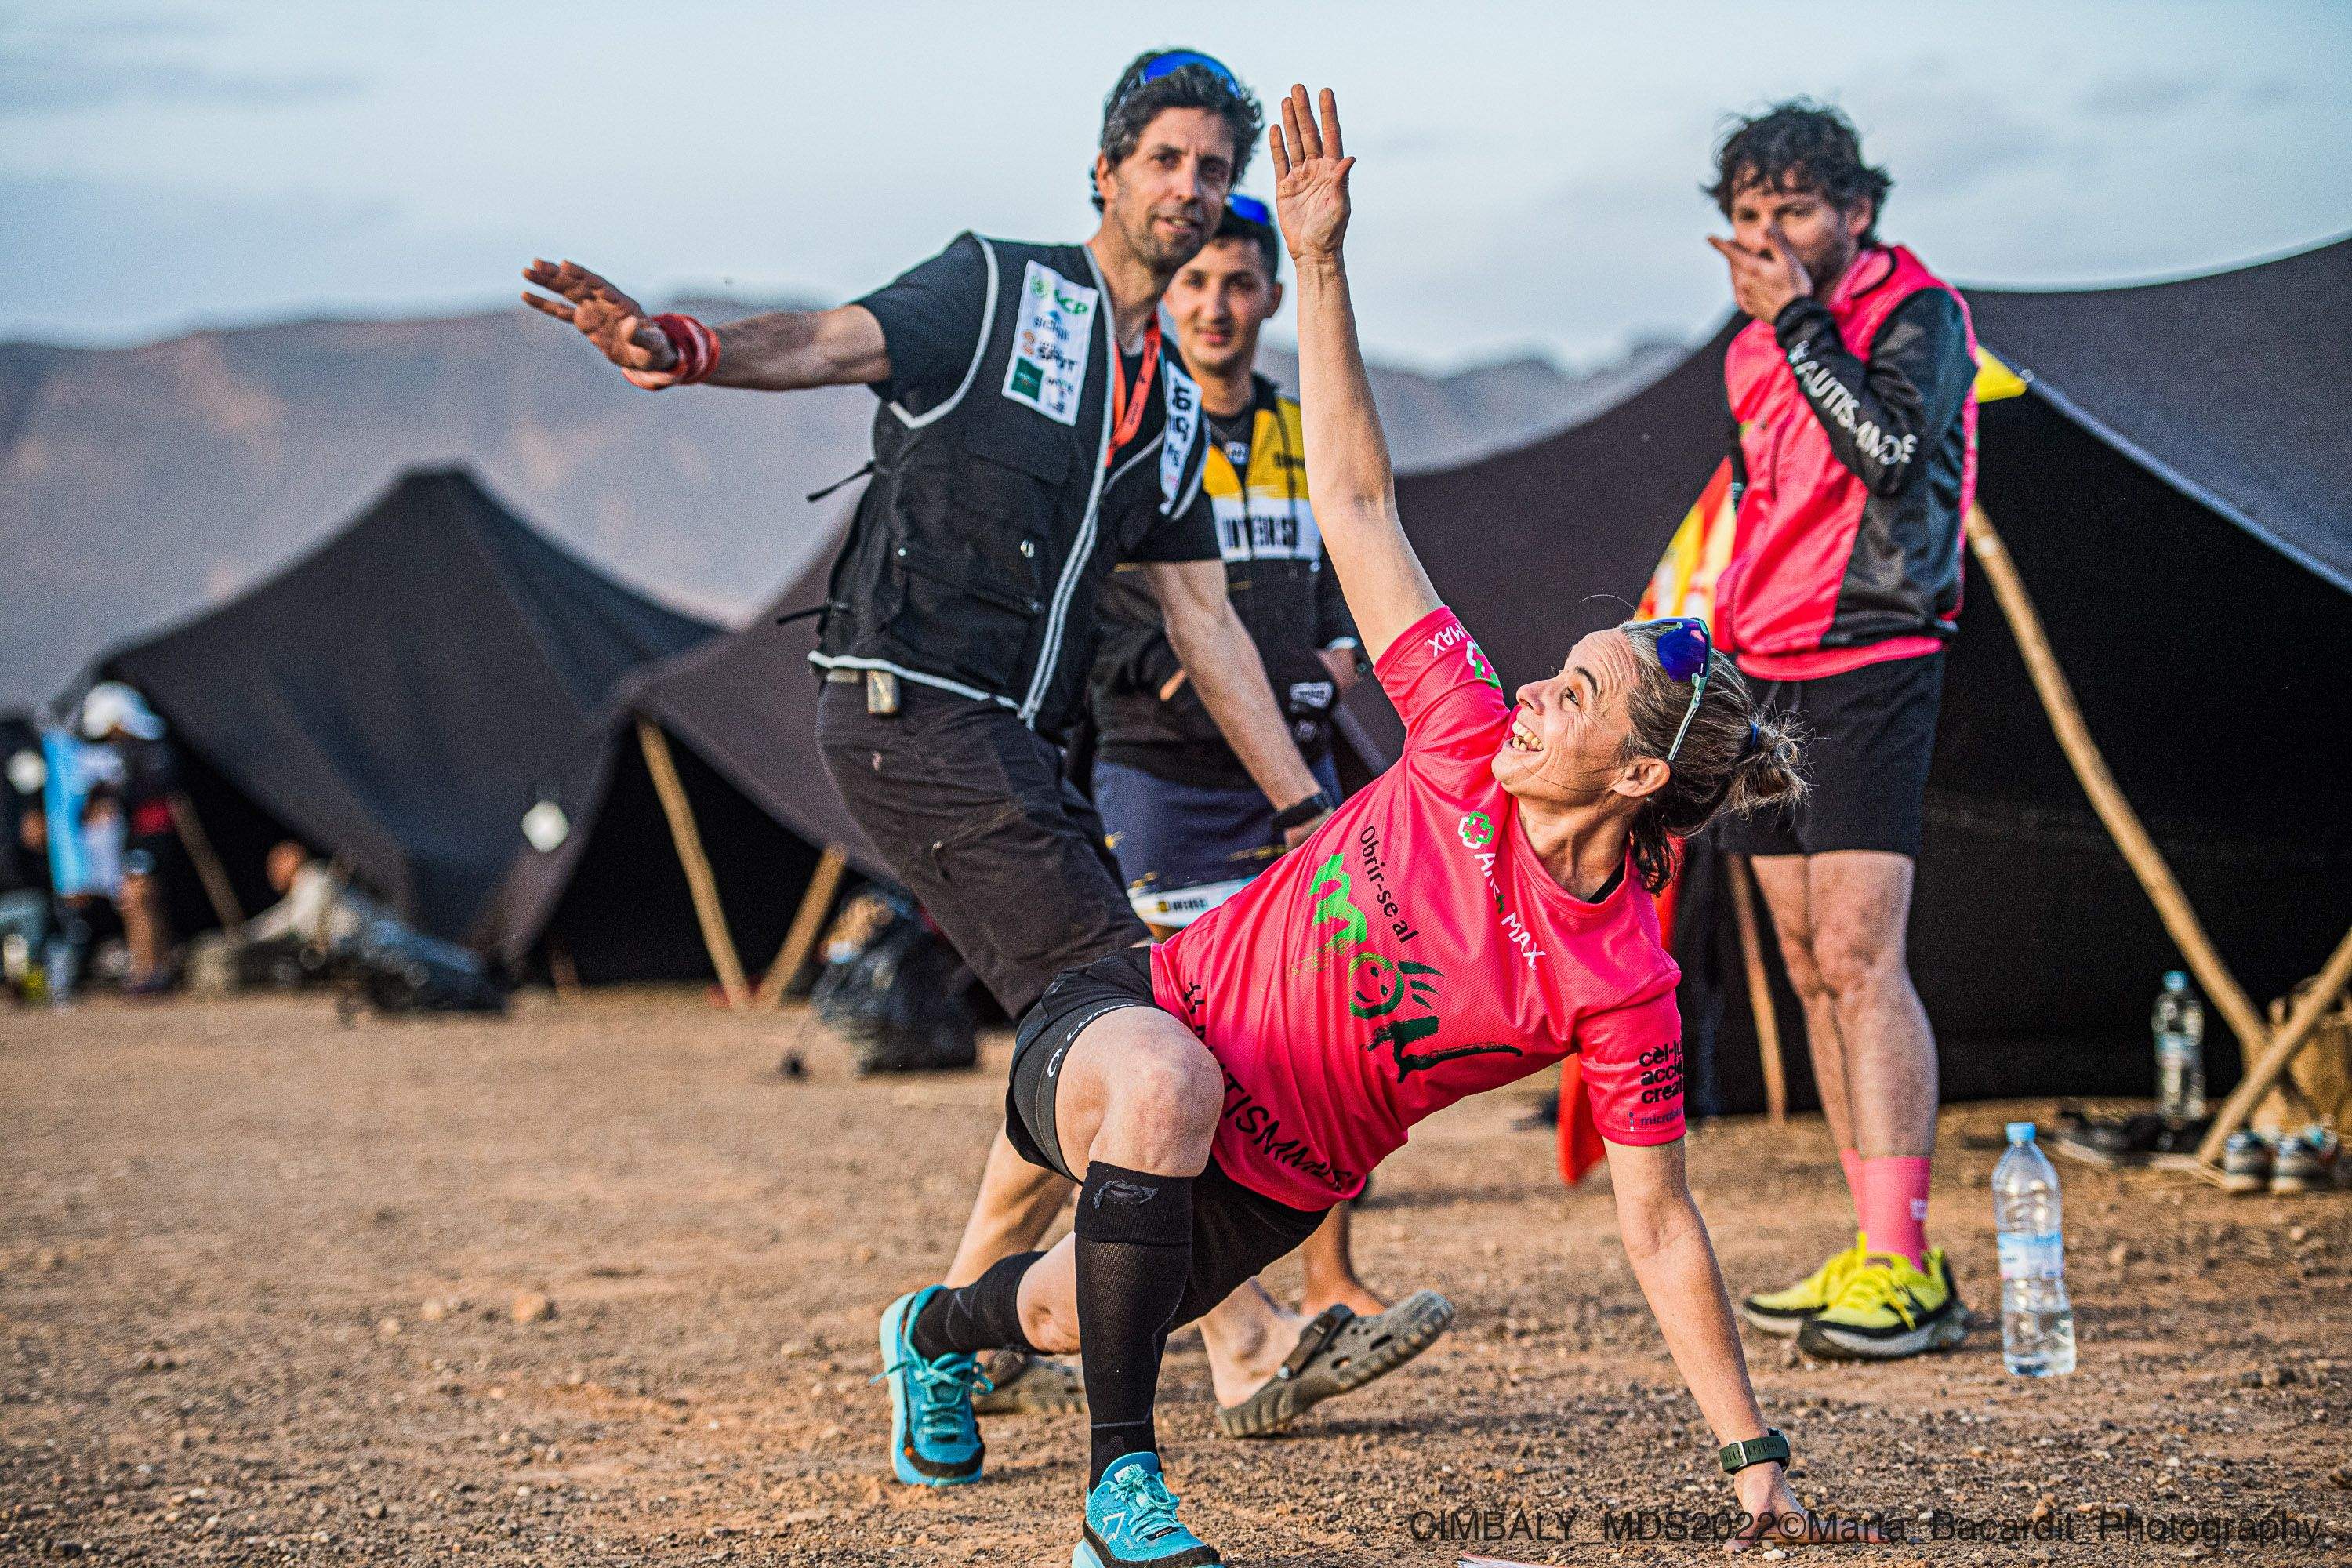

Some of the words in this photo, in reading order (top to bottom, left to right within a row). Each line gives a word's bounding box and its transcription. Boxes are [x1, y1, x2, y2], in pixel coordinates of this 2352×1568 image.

[1425, 622, 1467, 658] MAX
[1359, 825, 1399, 918] Obrir-se
[1392, 920, 1419, 944] al
[1501, 911, 1547, 971] MAX
